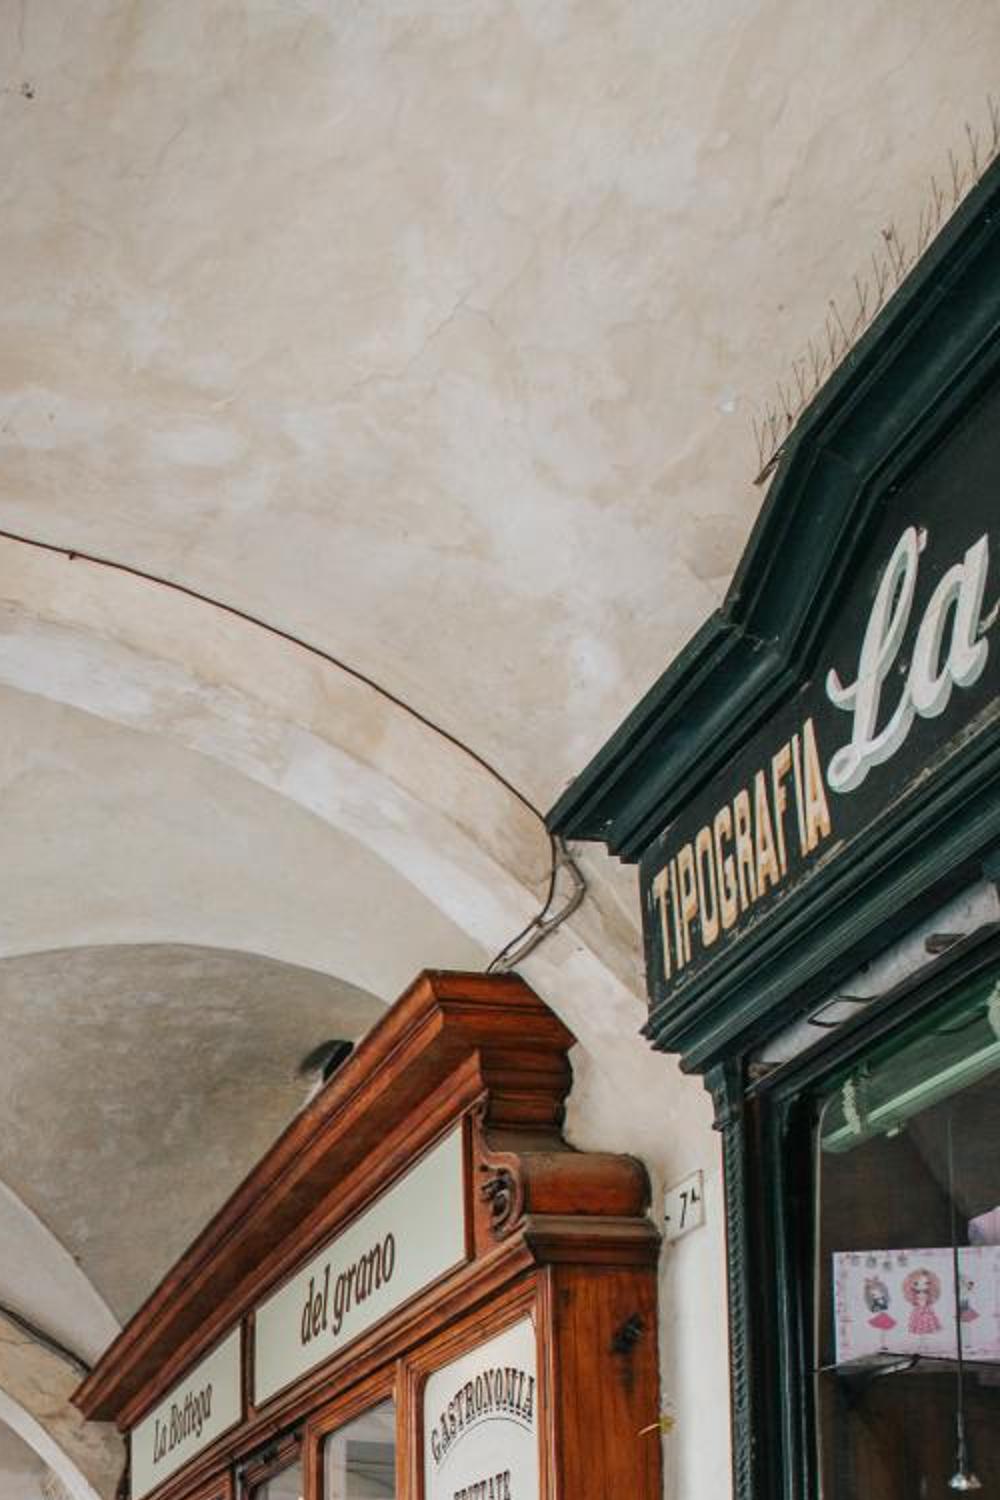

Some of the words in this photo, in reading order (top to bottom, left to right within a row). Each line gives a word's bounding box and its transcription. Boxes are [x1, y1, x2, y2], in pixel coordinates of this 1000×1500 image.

[826, 526, 989, 793] La
[652, 719, 832, 979] TIPOGRAFIA
[301, 1263, 331, 1345] del
[332, 1233, 395, 1336] grano
[153, 1419, 167, 1464] La
[168, 1383, 213, 1451] Bottega
[430, 1367, 535, 1463] GASTRONOMIA
